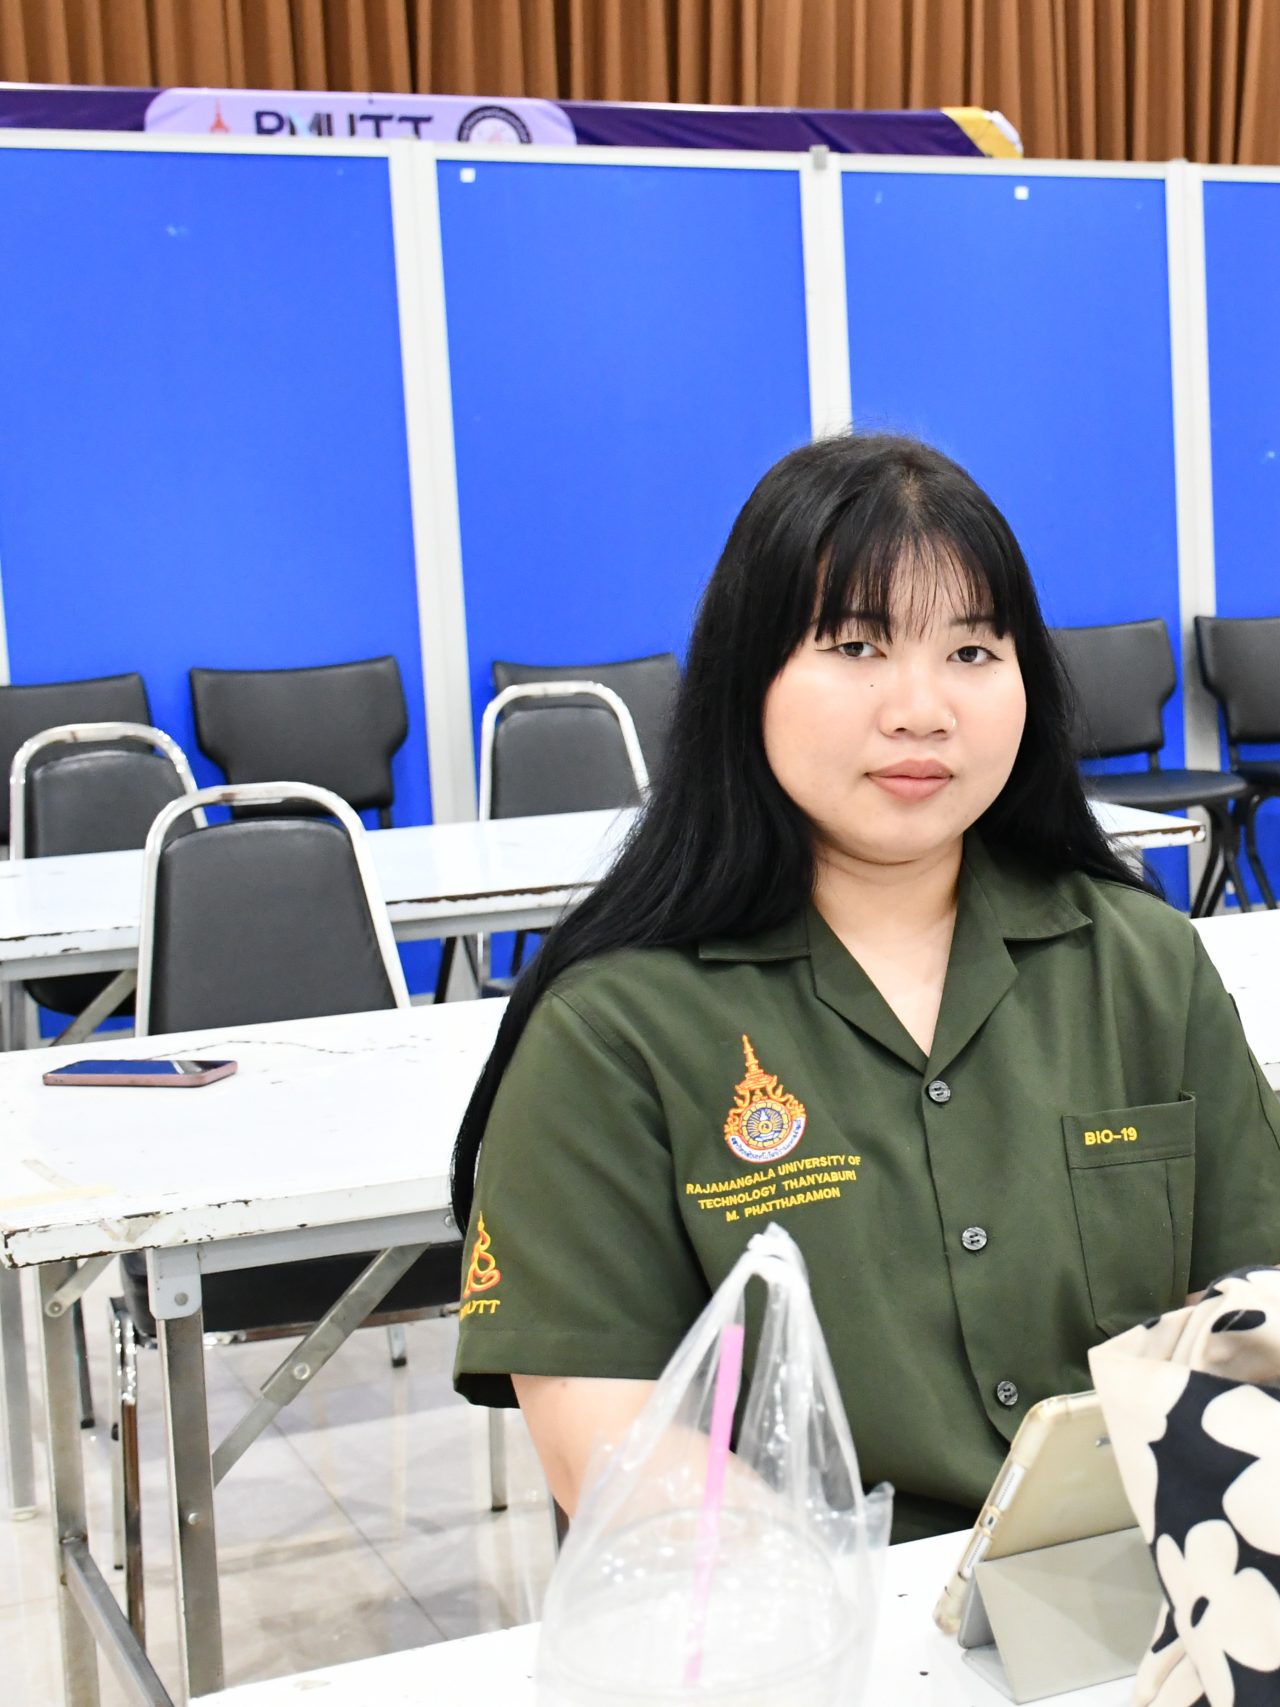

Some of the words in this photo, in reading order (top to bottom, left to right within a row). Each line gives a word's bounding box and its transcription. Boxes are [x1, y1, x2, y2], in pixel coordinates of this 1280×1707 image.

[1084, 1127, 1138, 1145] BIO-19
[686, 1168, 776, 1194] RAJAMANGALA
[778, 1155, 845, 1176] UNIVERSITY
[847, 1155, 861, 1165] OF
[698, 1185, 777, 1210] TECHNOLOGY
[782, 1170, 857, 1191] THANYABURI
[725, 1210, 740, 1222] M.
[744, 1187, 841, 1217] PHATTHARAMON
